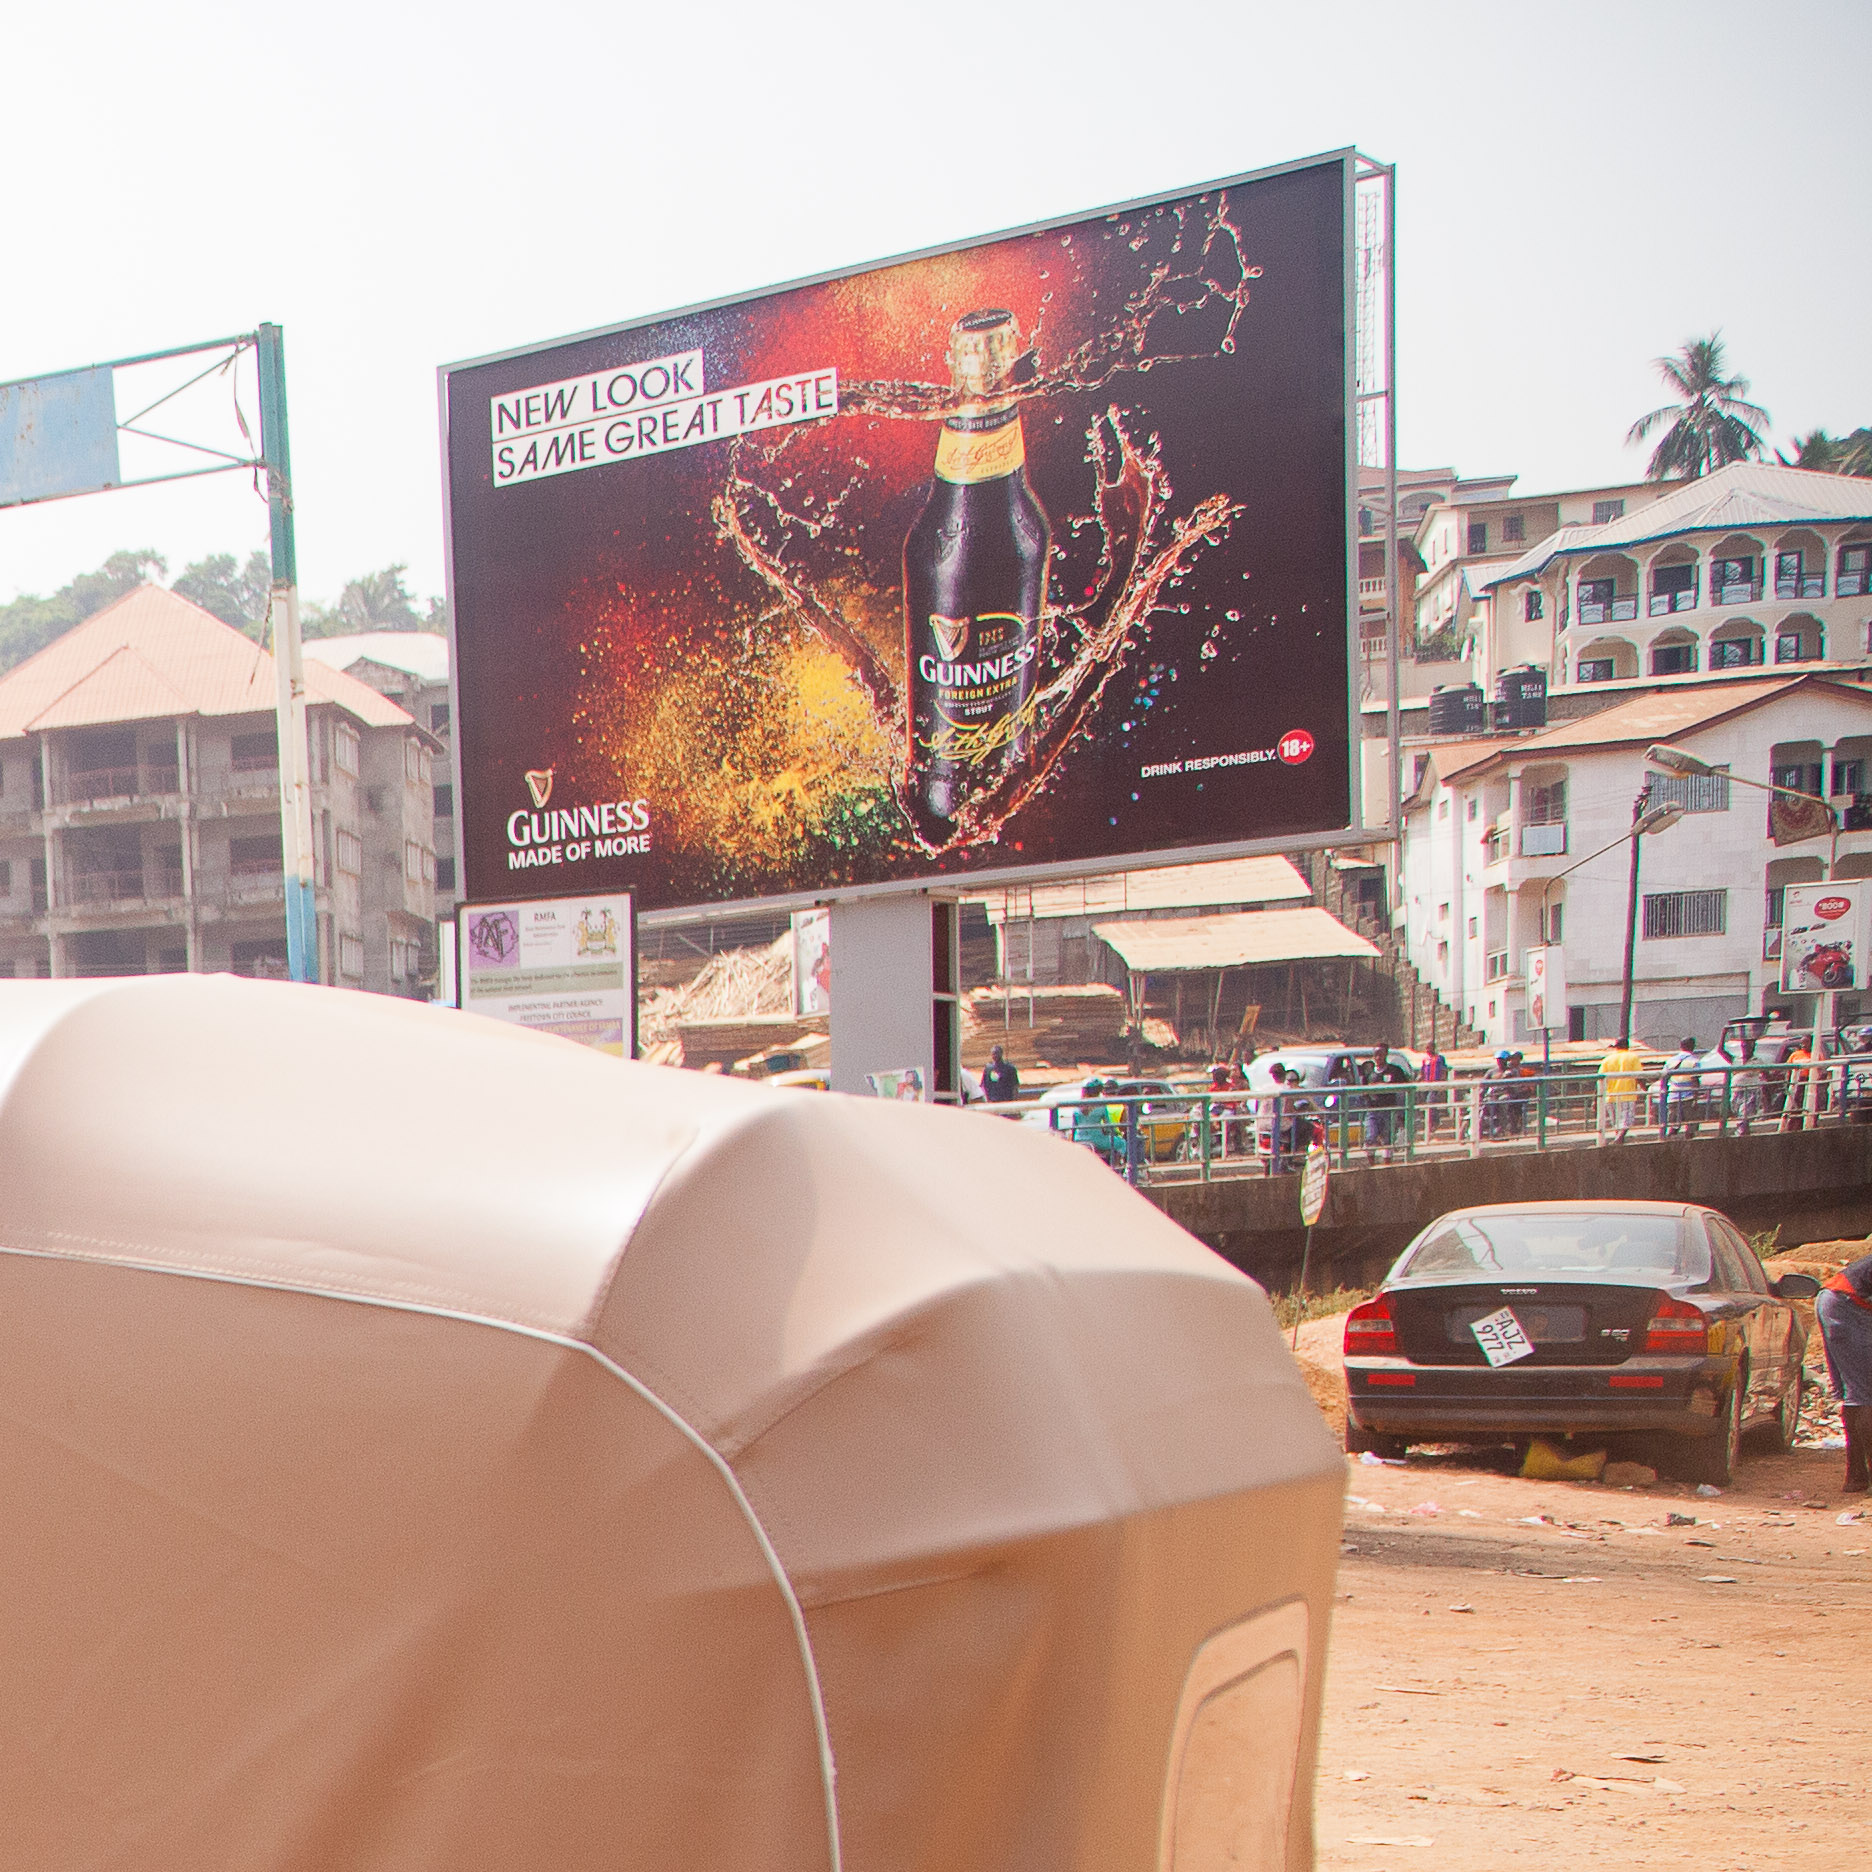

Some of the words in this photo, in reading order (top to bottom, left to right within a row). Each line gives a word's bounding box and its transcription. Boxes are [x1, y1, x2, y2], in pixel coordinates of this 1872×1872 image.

[497, 384, 579, 434] NEW
[591, 357, 695, 414] LOOK
[497, 428, 596, 480] SAME
[604, 398, 723, 455] GREAT
[734, 374, 834, 427] TASTE
[919, 635, 1039, 687] GUINNESS
[938, 688, 984, 701] FOREIGN
[986, 676, 1018, 699] EXTRA
[1141, 762, 1183, 778] DRINK
[1185, 749, 1276, 771] RESPONSIBLY.
[1282, 739, 1310, 757] 18+
[507, 799, 650, 847] GUINNESS
[508, 845, 563, 870] MADE
[565, 842, 591, 862] OF
[594, 834, 651, 858] MORE
[1476, 1323, 1505, 1351] 977
[1496, 1316, 1526, 1351] AJZ
